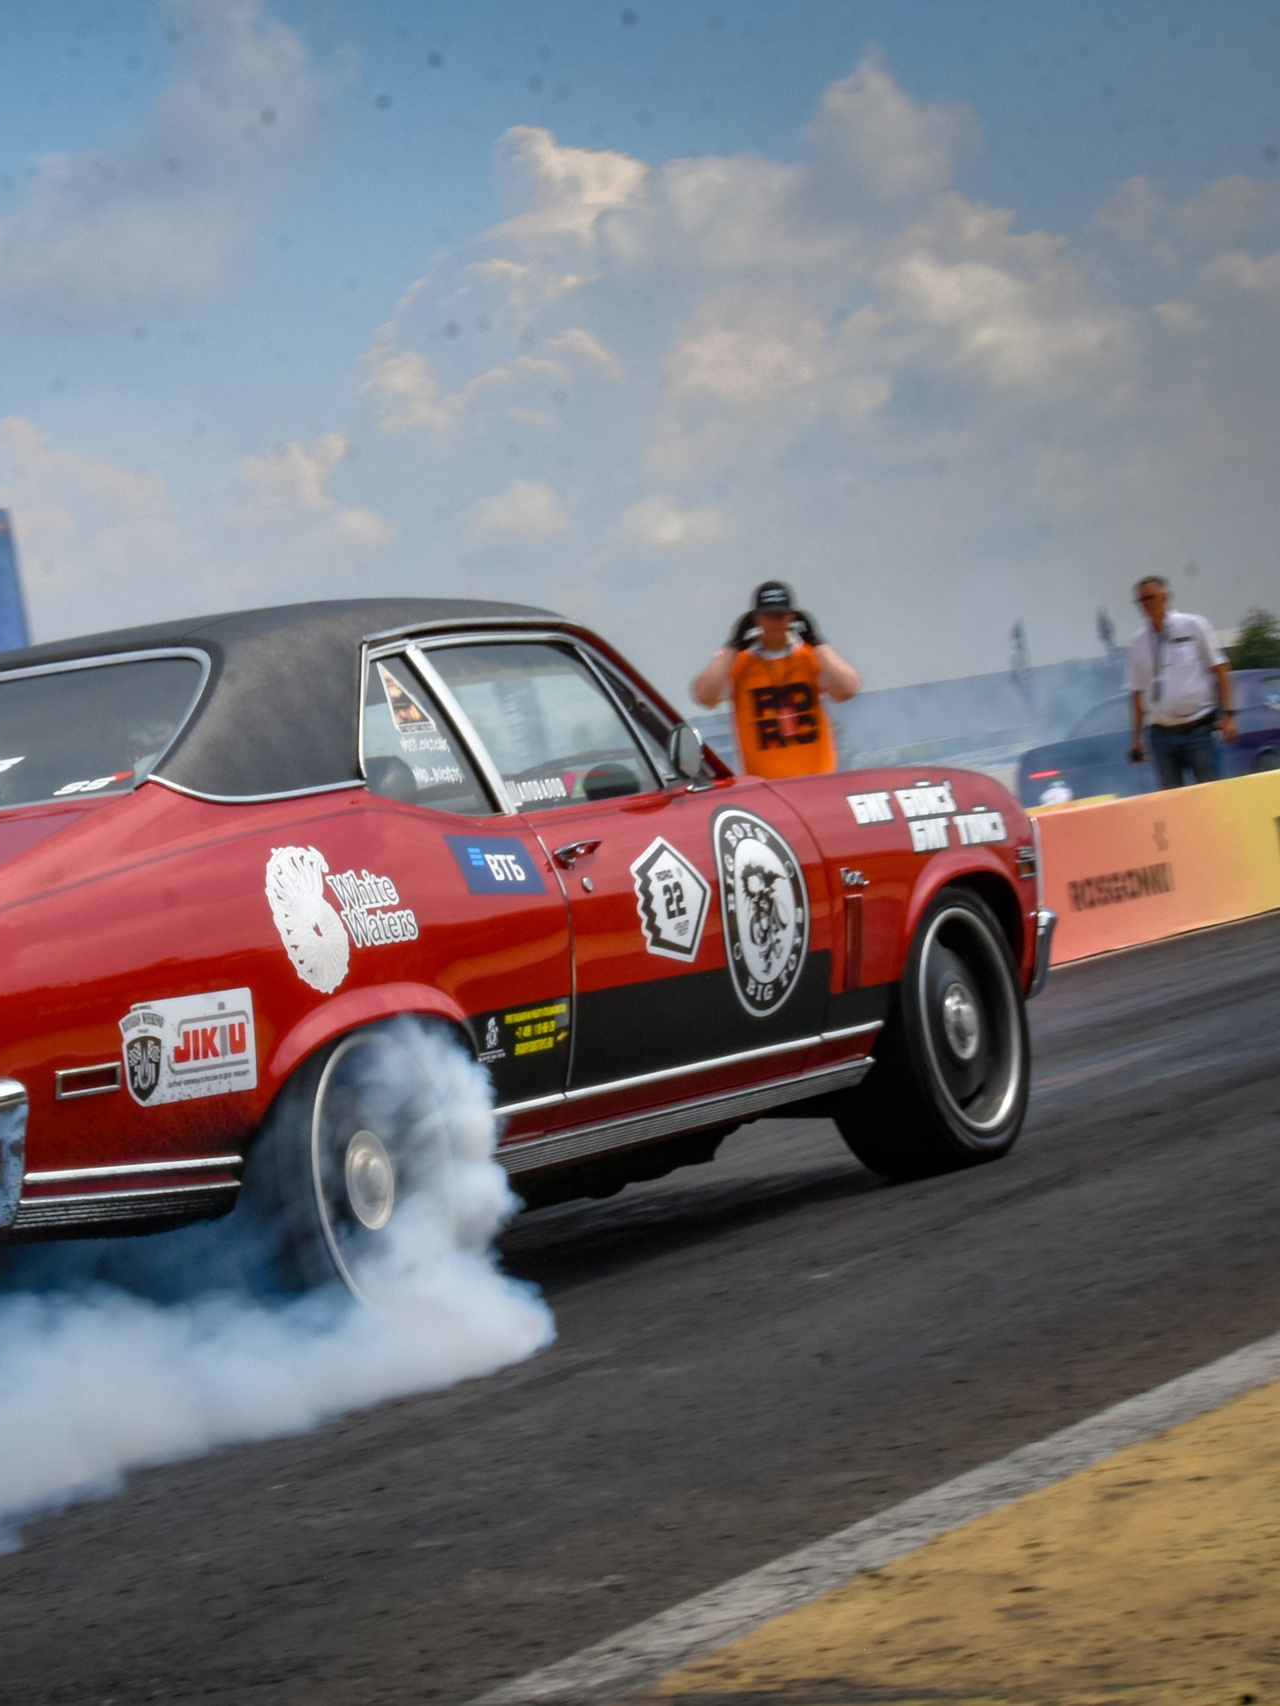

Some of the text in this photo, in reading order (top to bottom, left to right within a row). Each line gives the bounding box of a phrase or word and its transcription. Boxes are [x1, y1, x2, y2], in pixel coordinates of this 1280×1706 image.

[483, 854, 526, 881] ВТБ
[327, 871, 398, 909] White
[662, 881, 687, 920] 22
[342, 911, 418, 946] Waters
